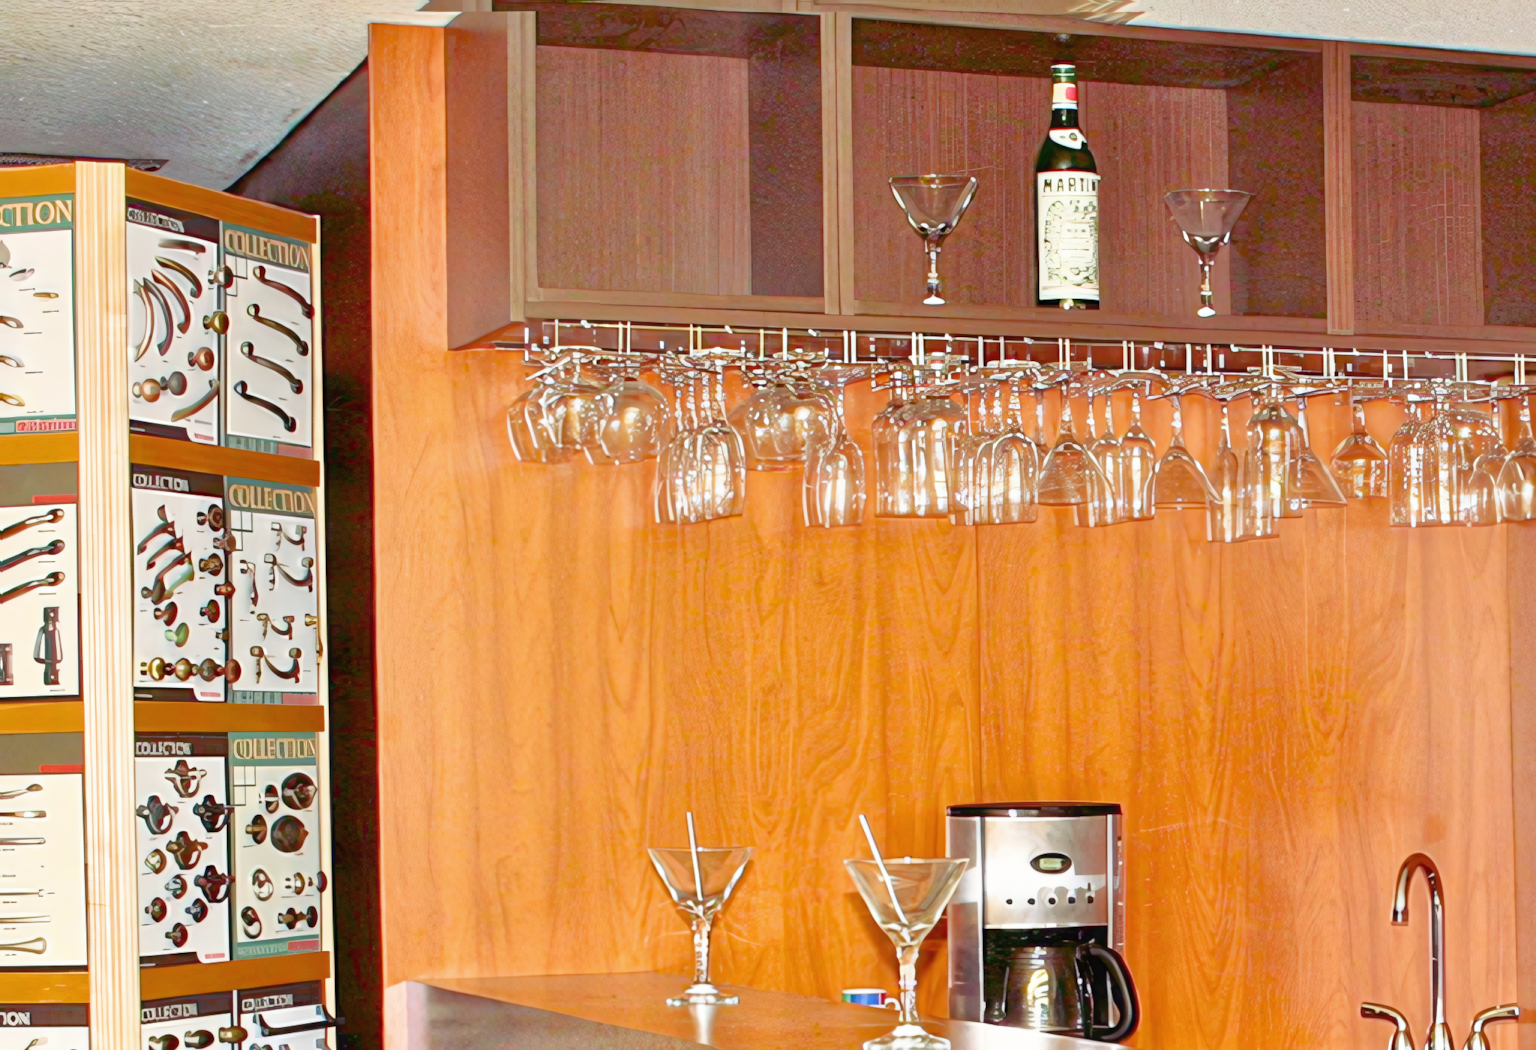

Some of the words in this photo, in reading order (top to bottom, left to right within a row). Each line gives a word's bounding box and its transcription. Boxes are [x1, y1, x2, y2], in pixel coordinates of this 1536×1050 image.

[225, 229, 310, 269] COLLECTION
[228, 484, 316, 517] COLLECTION
[233, 738, 316, 760] COLLECTION
